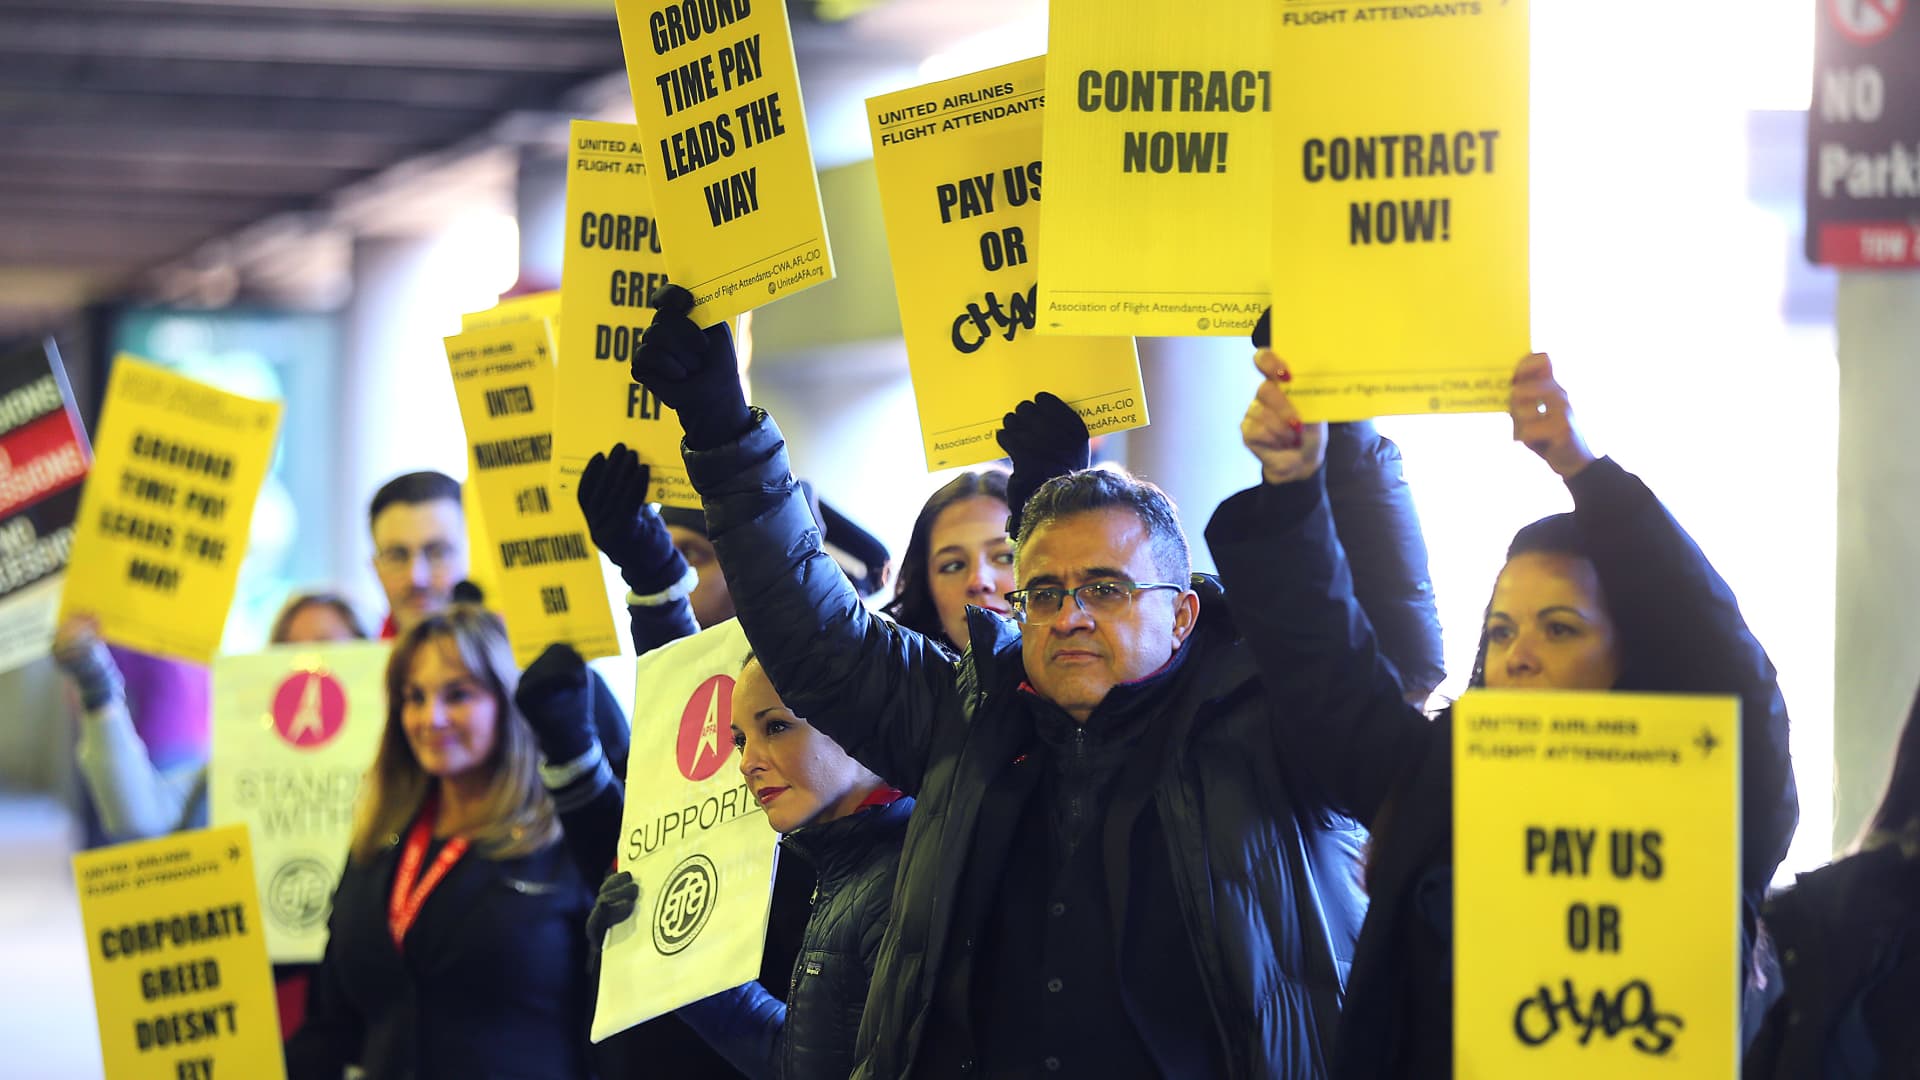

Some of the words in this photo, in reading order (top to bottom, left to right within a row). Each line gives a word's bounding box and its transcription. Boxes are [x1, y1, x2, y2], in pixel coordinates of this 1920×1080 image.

[1282, 9, 1348, 27] FLIGHT
[1353, 1, 1482, 23] ATTENDANTS
[656, 53, 718, 117] TIME
[718, 34, 763, 92] PAY
[1821, 65, 1884, 123] NO
[877, 102, 938, 126] UNITED
[942, 82, 1014, 110] AIRLINES
[881, 122, 937, 147] FLIGHT
[942, 95, 1046, 132] ATTENDANTS
[578, 139, 626, 153] UNITED
[660, 113, 735, 182] LEADS
[735, 92, 785, 149] THE
[1123, 132, 1228, 173] NOW!
[1302, 130, 1500, 183] CONTRACT
[577, 159, 622, 173] FLIGHT
[704, 167, 759, 228] WAY
[936, 172, 995, 224] PAY
[1002, 161, 1043, 207] US
[1349, 198, 1451, 246] NOW!
[979, 226, 1028, 272] OR
[714, 287, 721, 299] of
[721, 284, 738, 296] Flight
[1049, 301, 1106, 313] Association
[1110, 302, 1121, 312] of
[1123, 302, 1150, 315] Flight
[933, 433, 982, 451] Association
[984, 431, 993, 441] of
[628, 784, 762, 861] SUPPORT
[1525, 825, 1595, 877] PAY
[1609, 830, 1664, 881] US
[98, 903, 248, 961] CORPORATE
[1567, 902, 1621, 955] OR
[141, 957, 221, 1001] GREED
[134, 1002, 238, 1053] DOESN'T
[1513, 978, 1685, 1056] CHAOS
